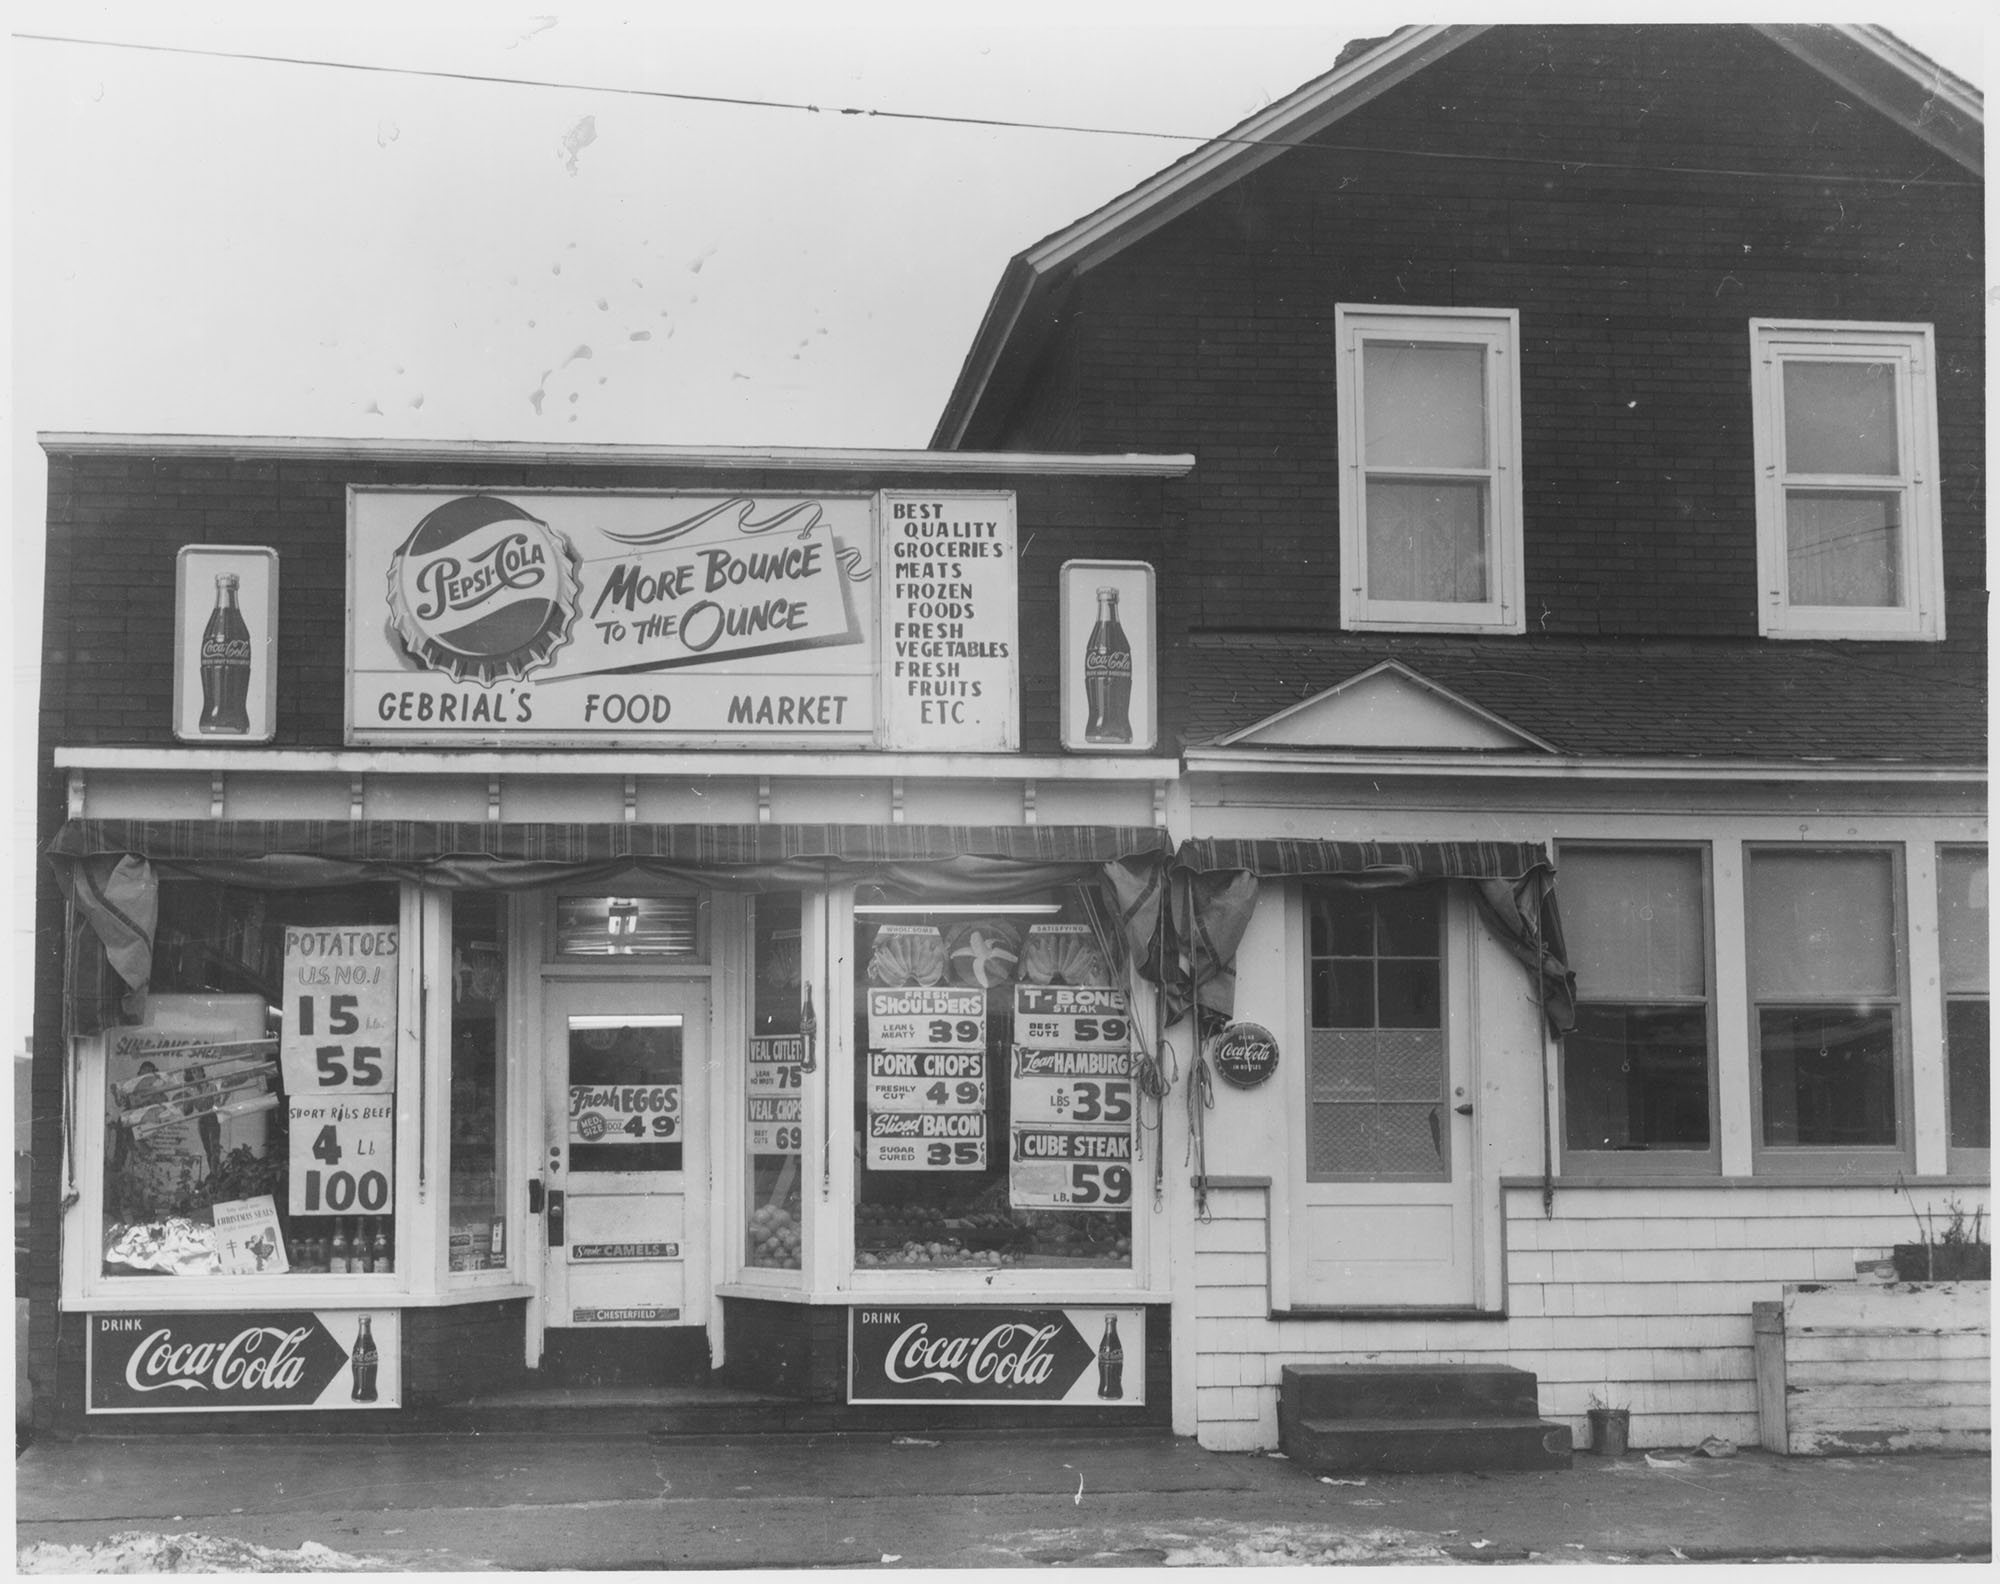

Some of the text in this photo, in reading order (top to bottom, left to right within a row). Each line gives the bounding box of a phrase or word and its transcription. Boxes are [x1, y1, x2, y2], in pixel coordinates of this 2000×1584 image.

[893, 504, 943, 519] BEST
[904, 522, 997, 539] QUALITY
[894, 542, 1003, 558] GROCERIES
[896, 562, 962, 579] MEATS
[591, 543, 822, 619] MORE BOUNCE
[896, 583, 973, 599] FROZEN
[908, 602, 975, 619] FOODS
[595, 600, 808, 652] TO THE OUNCE
[894, 622, 963, 639] FRESH
[896, 641, 1009, 658] VEGETABLES
[895, 662, 960, 677] FRESH
[908, 680, 982, 697] FRUITS
[378, 687, 848, 725] GEBRIAL'S FOOD MARKET
[286, 932, 398, 956] POTATOES
[875, 995, 982, 1015] SHOULDERS
[905, 991, 949, 999] FRESH
[1024, 990, 1124, 1011] T-BONE
[299, 995, 359, 1035] 15
[1053, 1004, 1097, 1014] STEAK
[882, 1031, 915, 1039] MEATY
[750, 1040, 771, 1060] VEAL
[316, 1045, 382, 1086] 55
[874, 1054, 981, 1076] PORK CHOPS
[1023, 1051, 1129, 1074] Lean HAMBURG
[569, 1086, 678, 1117] Fresh EGGS
[750, 1100, 773, 1120] VEAL
[1073, 1082, 1131, 1121] 35
[289, 1108, 325, 1119] SHORT
[363, 1107, 391, 1119] BEEF
[583, 1125, 603, 1136] SIZE
[873, 1114, 980, 1136] Sliced BACON
[312, 1124, 342, 1165] 4
[776, 1126, 801, 1150] 69
[1024, 1135, 1129, 1157] CUBE STEAK
[305, 1170, 388, 1211] 100
[1072, 1164, 1131, 1204] 59
[217, 1212, 252, 1226] CHRISTMAS
[604, 1244, 660, 1256] CAMELS
[101, 1319, 142, 1331] DRINK
[597, 1310, 656, 1320] CHESTERFIELD
[862, 1312, 901, 1324] DRINK
[125, 1326, 314, 1391] Coca-Cola
[884, 1322, 1063, 1384] Coca-Cola
